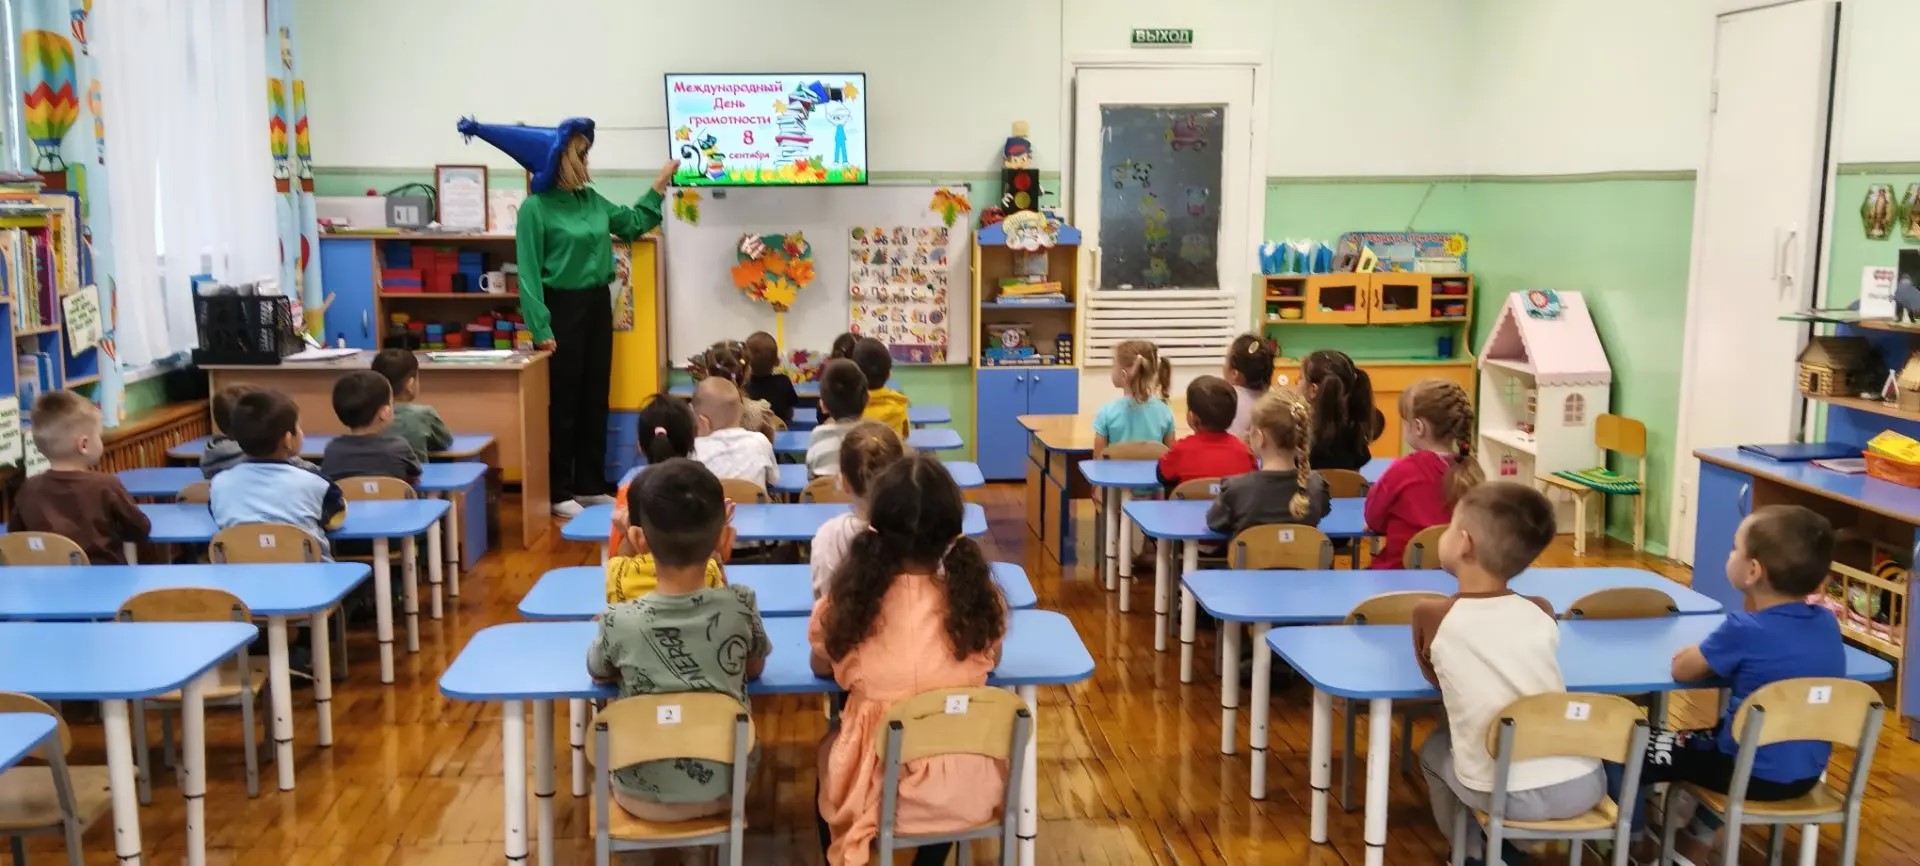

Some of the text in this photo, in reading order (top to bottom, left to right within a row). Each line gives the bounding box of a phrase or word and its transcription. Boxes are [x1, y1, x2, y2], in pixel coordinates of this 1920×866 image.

[1135, 30, 1189, 42] ВЫХОД
[673, 81, 784, 96] Международный
[712, 97, 746, 111] День
[689, 115, 771, 127] грамотности
[743, 130, 754, 145] 8
[728, 151, 770, 160] сентября
[665, 708, 673, 720] 2
